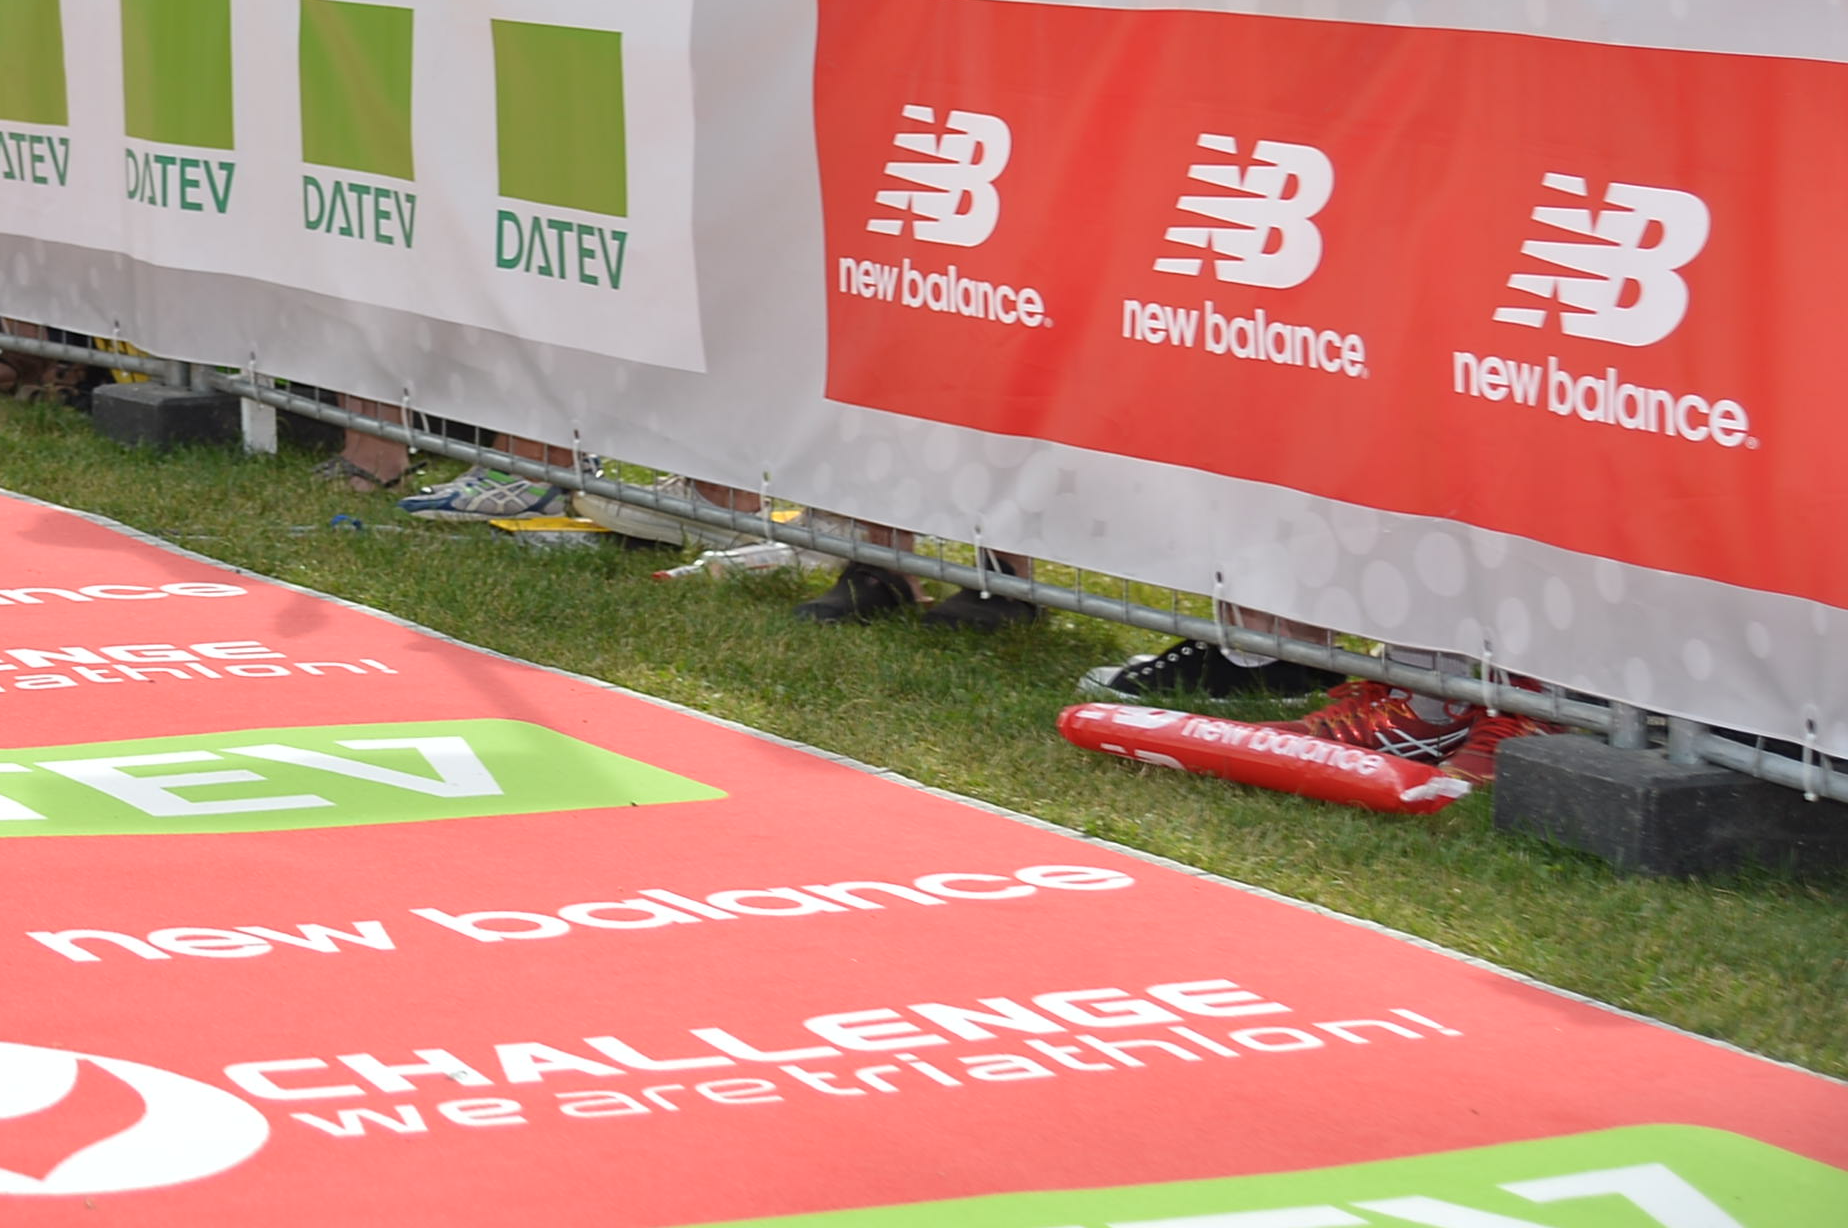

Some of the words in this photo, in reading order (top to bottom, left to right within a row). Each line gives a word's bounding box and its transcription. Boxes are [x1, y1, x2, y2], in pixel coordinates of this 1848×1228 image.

[124, 147, 237, 215] DATEV
[301, 173, 417, 250] DATEV
[495, 208, 628, 291] DATEV
[838, 255, 901, 302] new
[1121, 298, 1200, 349] new
[1452, 350, 1543, 408] new
[1180, 713, 1252, 752] new
[1248, 725, 1388, 778] balance
[27, 919, 398, 964] new
[408, 863, 1136, 943] balance
[224, 978, 1294, 1102] CHALLENGE
[289, 1097, 530, 1138] we
[552, 1073, 785, 1120] are
[780, 1007, 1464, 1098] triathlon!
